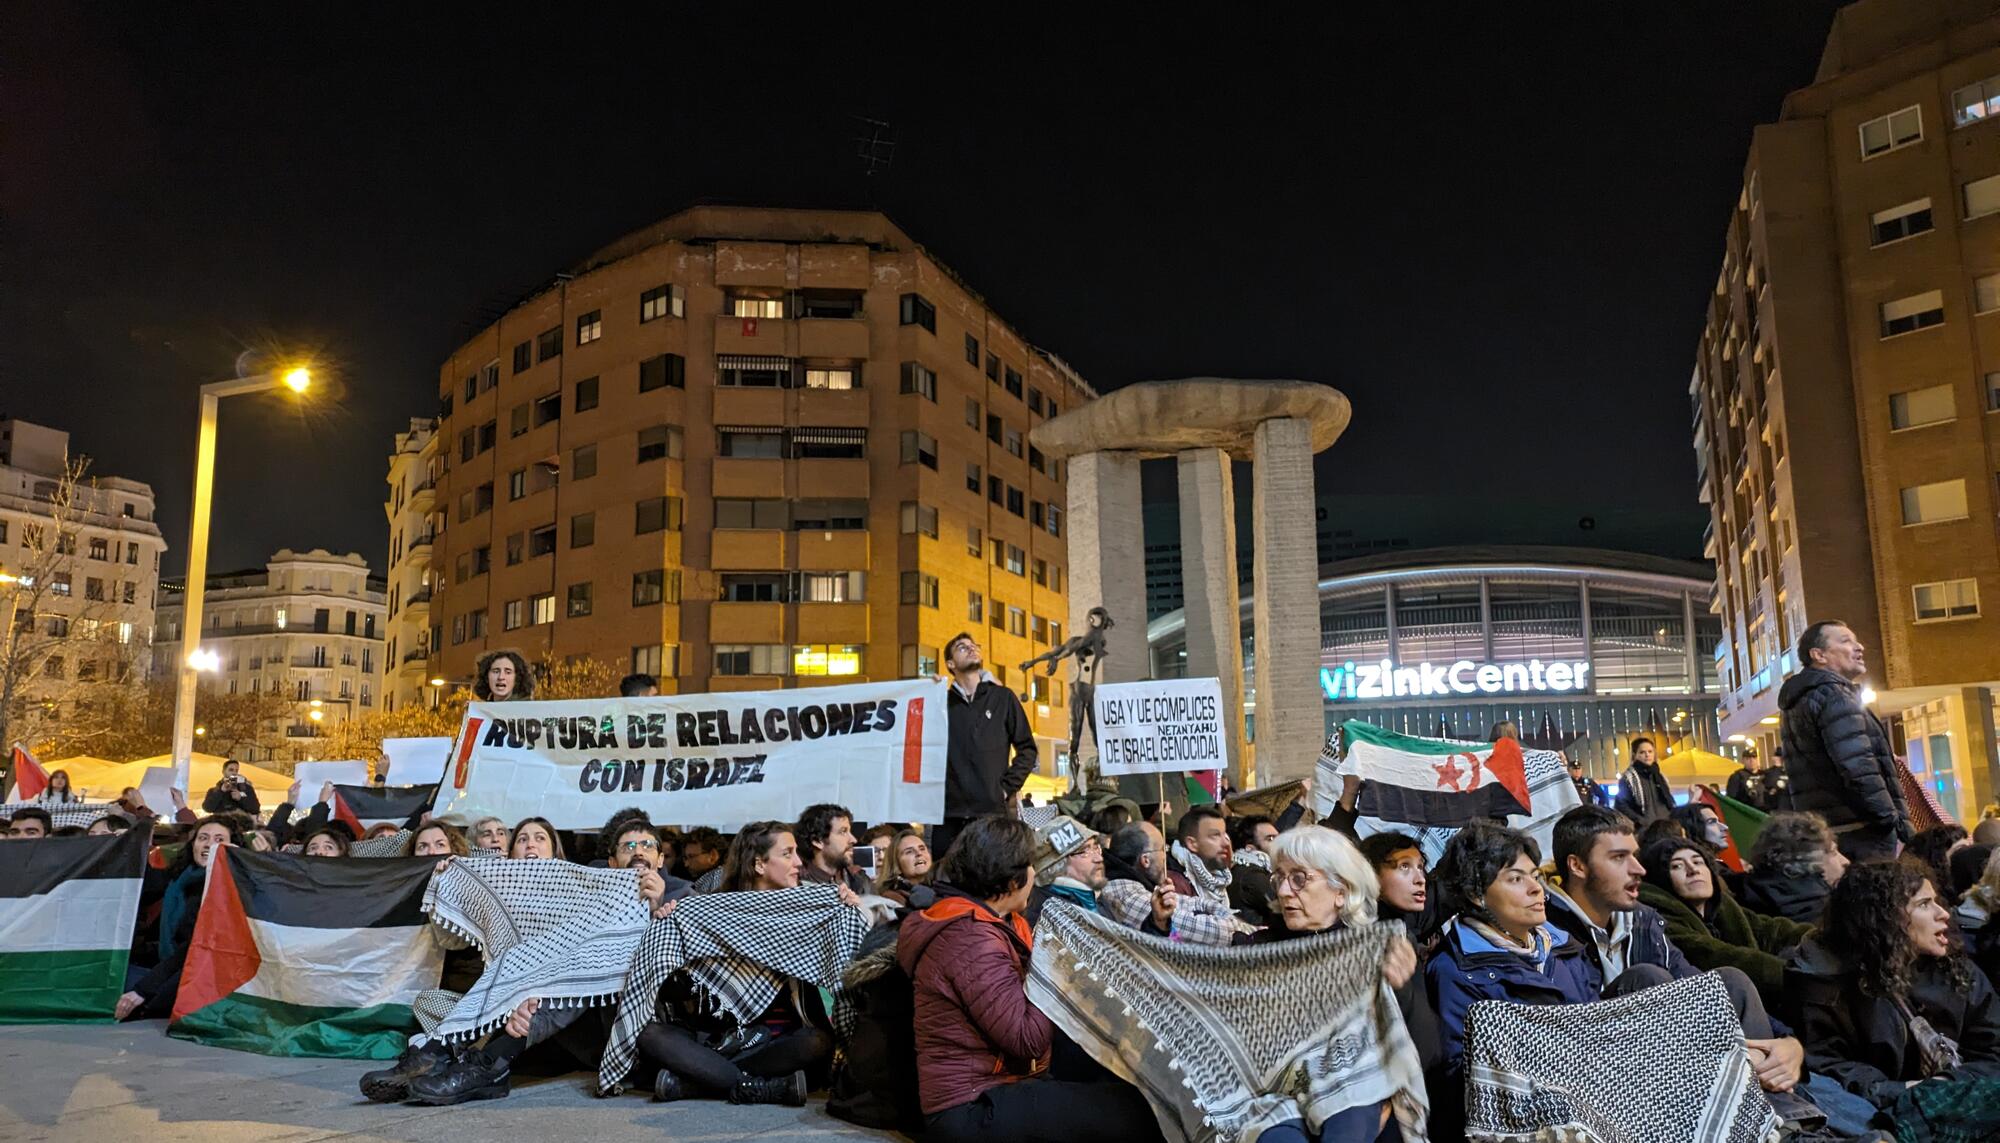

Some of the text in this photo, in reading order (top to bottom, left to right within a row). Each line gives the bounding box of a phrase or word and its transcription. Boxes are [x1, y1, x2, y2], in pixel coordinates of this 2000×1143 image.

[1102, 692, 1216, 725] USA Y UE CÓMPLICES
[483, 700, 898, 750] RUPTURA DE RELACIONES
[1158, 723, 1218, 736] NETANYAHU
[1105, 735, 1219, 764] DE ISRAEL GENOCIDA!
[579, 754, 768, 793] CON ISRAEL
[1050, 823, 1081, 851] PAZ
